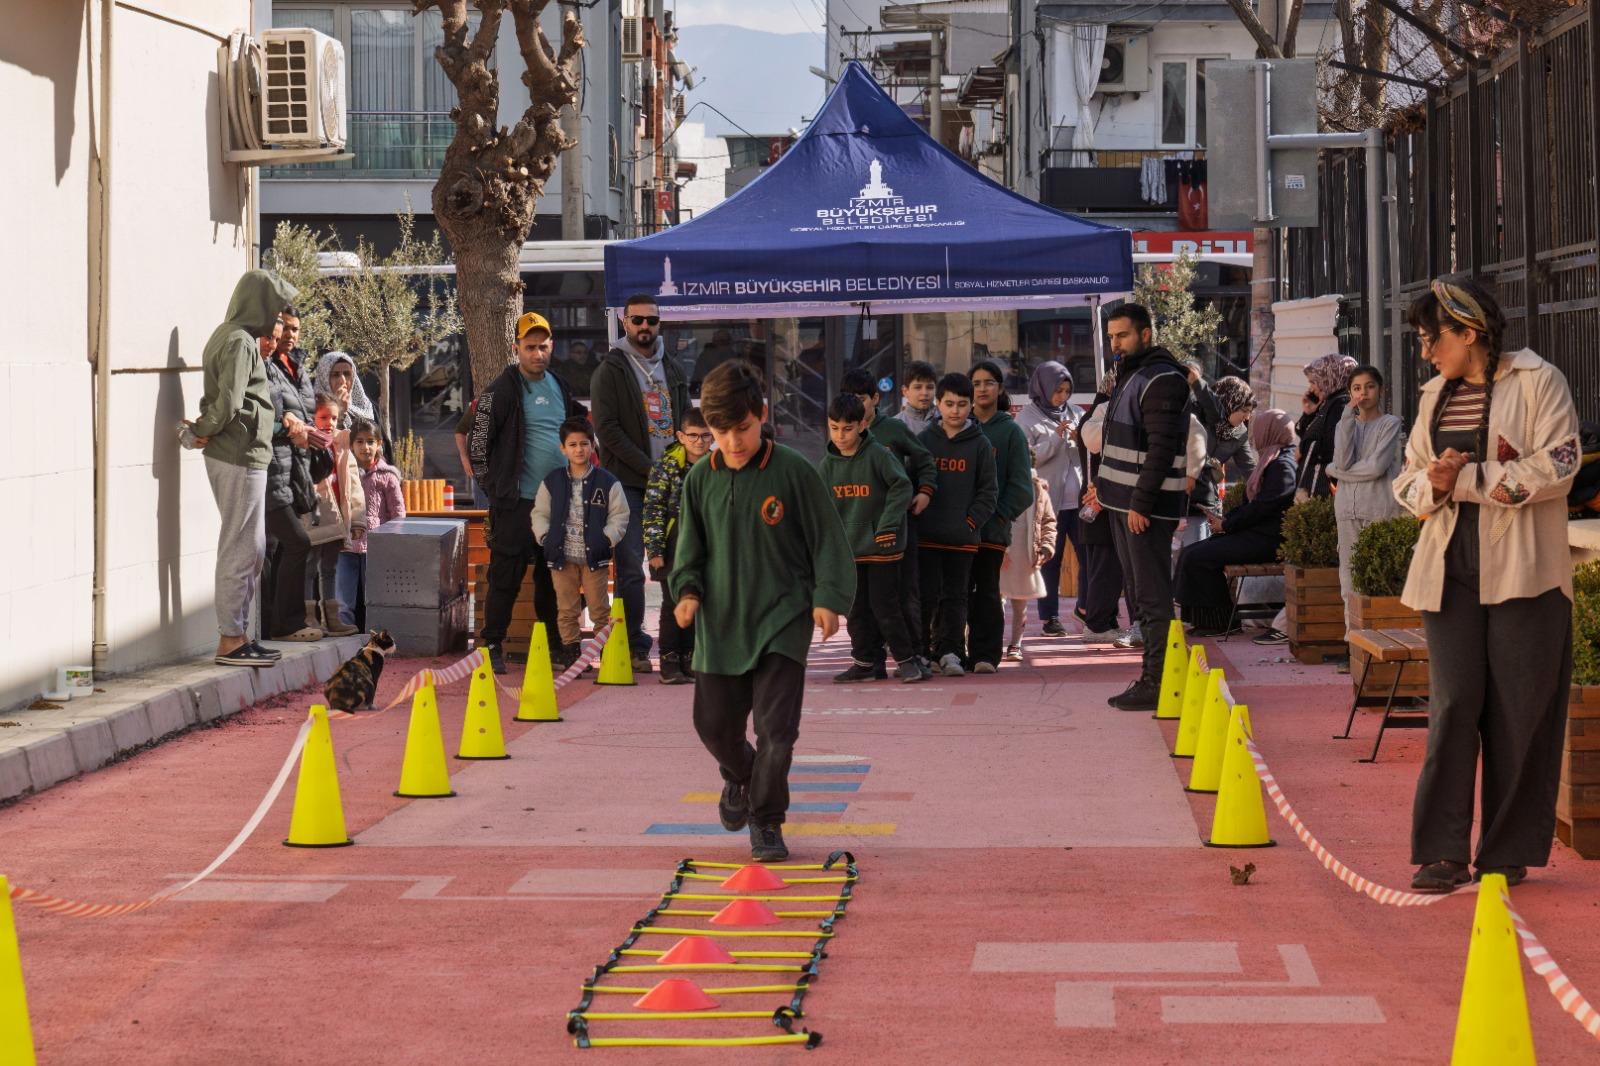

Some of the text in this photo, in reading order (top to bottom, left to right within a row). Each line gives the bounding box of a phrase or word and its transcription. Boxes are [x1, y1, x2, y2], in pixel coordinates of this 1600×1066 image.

[735, 278, 841, 295] BÜYÜKŞEHİR
[846, 275, 941, 292] BELEDİYESİ
[954, 280, 985, 289] SOSYAL
[591, 488, 606, 505] A
